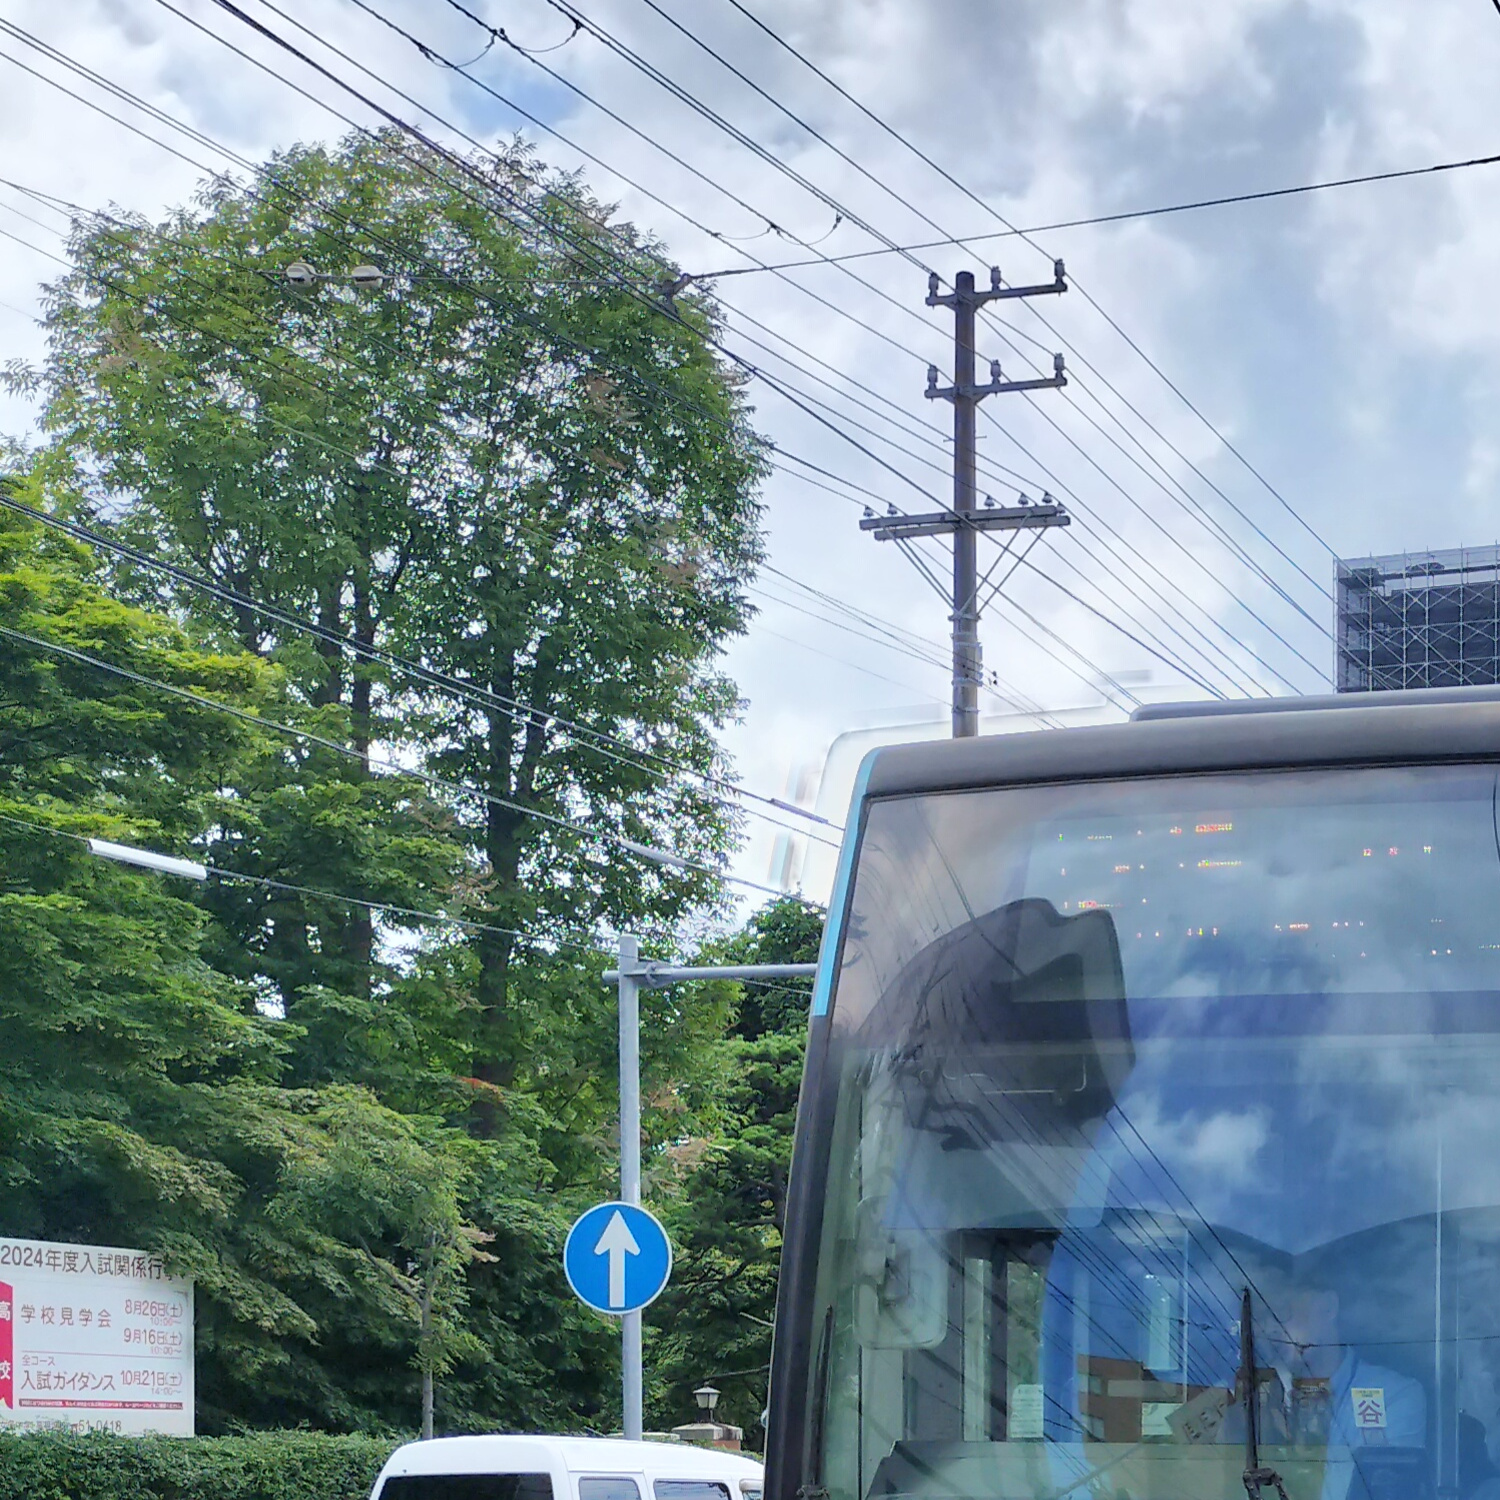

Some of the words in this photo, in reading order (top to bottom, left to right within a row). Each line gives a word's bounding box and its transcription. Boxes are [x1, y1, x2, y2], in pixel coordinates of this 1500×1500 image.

[21, 1304, 112, 1328] 学校見学会
[22, 1355, 56, 1367] 全コース
[21, 1369, 117, 1392] 入試ガイダンス
